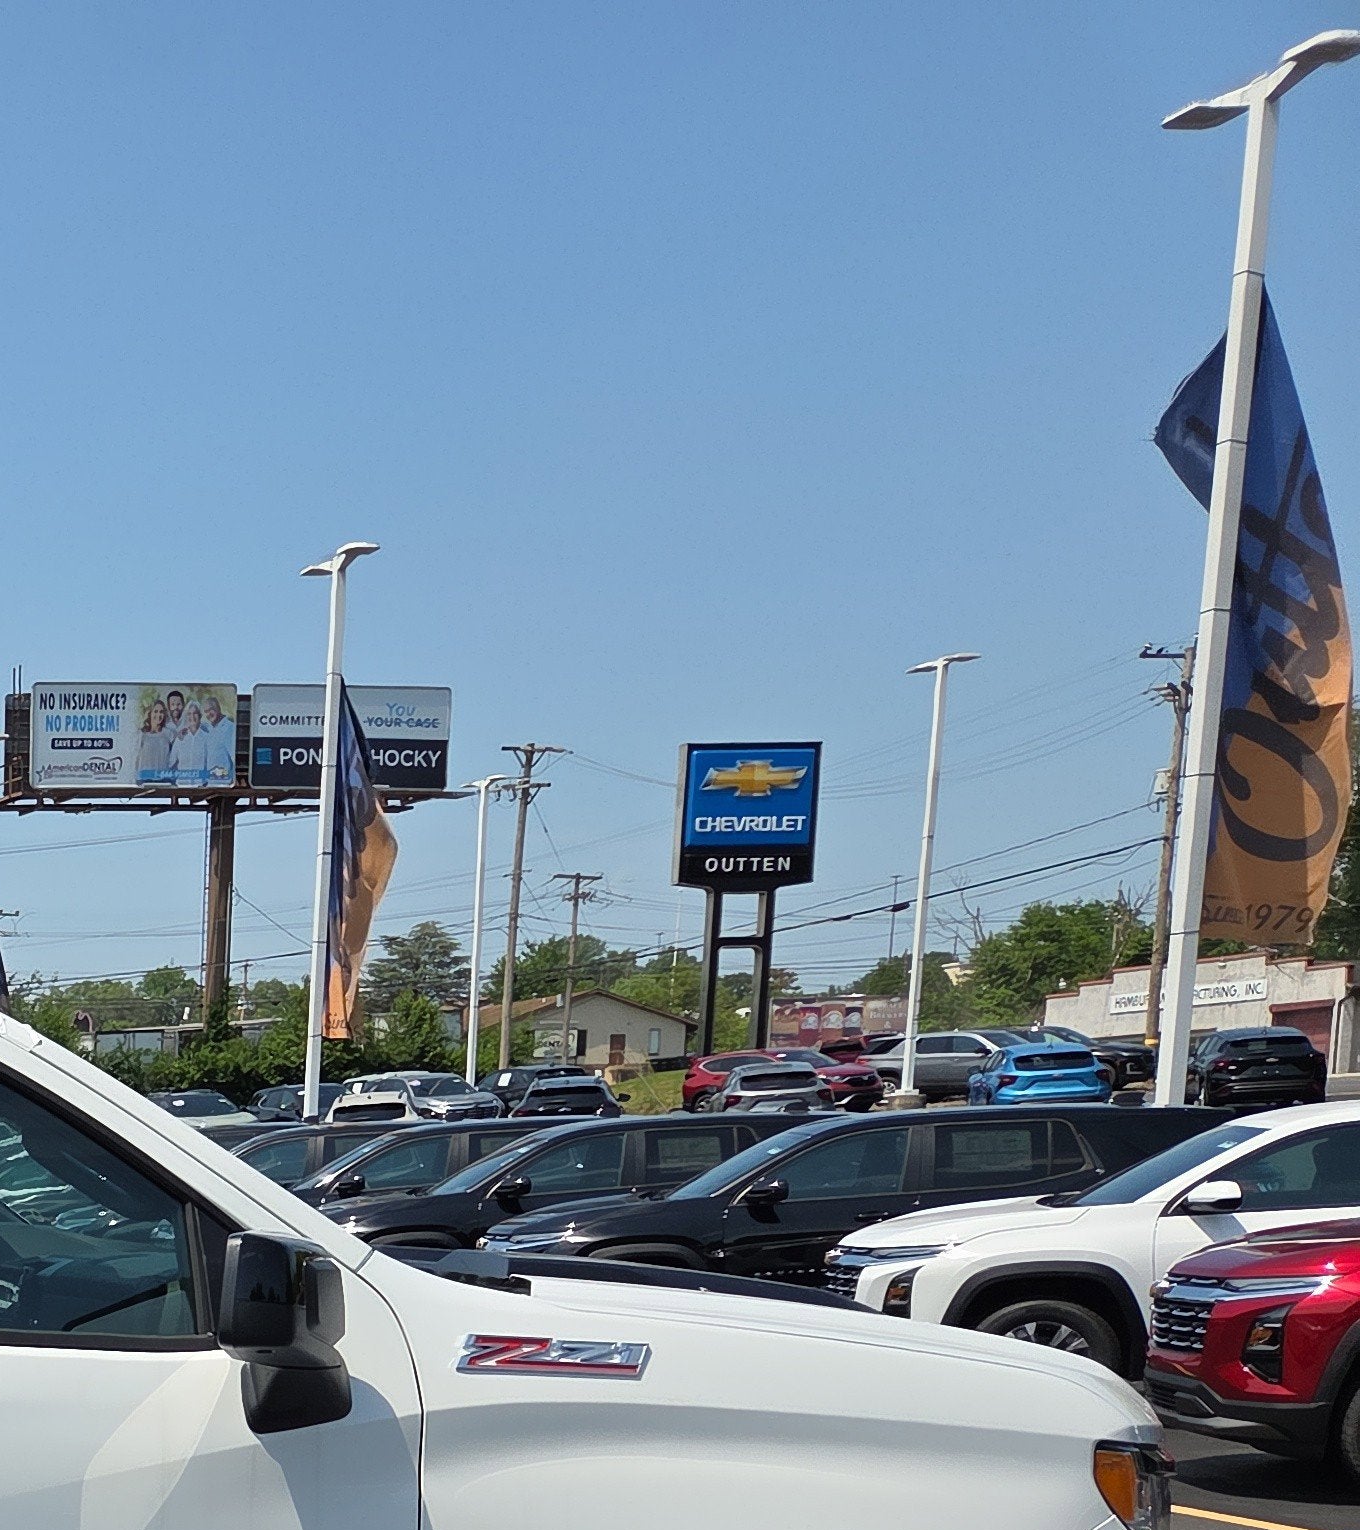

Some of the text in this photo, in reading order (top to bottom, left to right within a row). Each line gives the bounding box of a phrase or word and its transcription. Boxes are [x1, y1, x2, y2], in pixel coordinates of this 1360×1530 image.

[39, 693, 127, 711] NO INSURANCE?
[385, 702, 416, 717] YOU
[45, 715, 120, 732] NO PROBLEM!
[259, 715, 325, 726] COMMITT
[366, 716, 403, 728] YOUR
[279, 748, 442, 768] PON HOCKY
[694, 815, 807, 833] CHEVROLET
[704, 856, 791, 873] OUTTEN
[1245, 903, 1315, 933] 1979
[1114, 994, 1147, 1009] HAMBU
[455, 1333, 653, 1381] Z71
